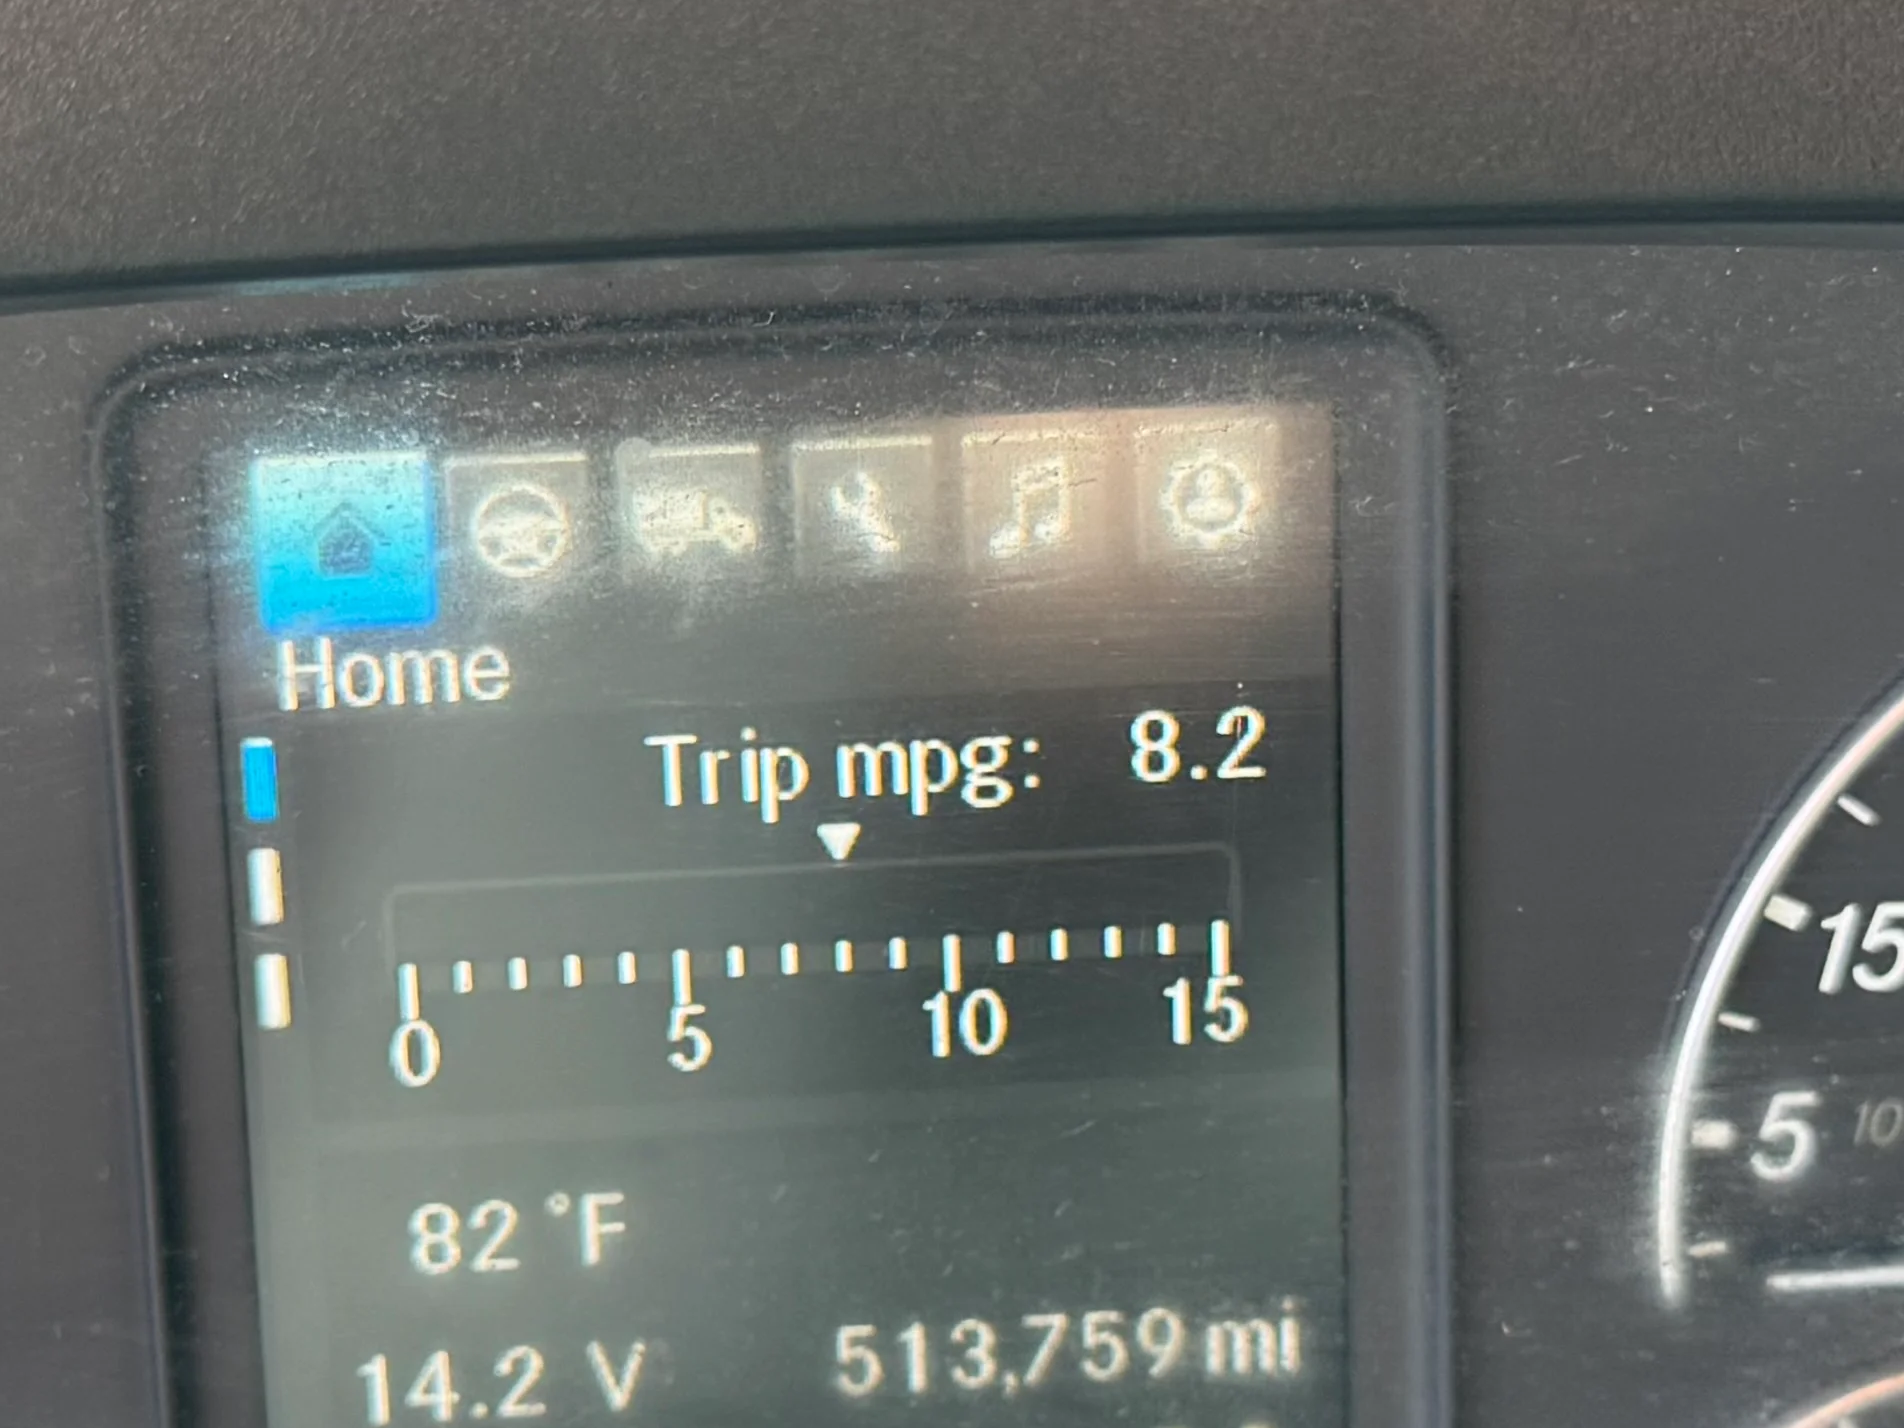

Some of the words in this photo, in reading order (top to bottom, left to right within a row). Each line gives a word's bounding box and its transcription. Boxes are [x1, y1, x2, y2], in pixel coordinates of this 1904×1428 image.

[276, 637, 512, 712] Home
[644, 725, 811, 823] Trip
[837, 733, 1042, 818] mpg:
[1129, 706, 1267, 786] 8.2
[390, 1018, 442, 1089] 0
[667, 1002, 712, 1074] 5
[922, 987, 1008, 1059] 10
[1163, 975, 1249, 1046] 15
[1750, 1089, 1822, 1182] 5
[408, 1197, 521, 1276] 82
[355, 1346, 548, 1428] 14.2
[588, 1338, 648, 1412] V
[833, 1306, 1183, 1399] 513,759
[1203, 1297, 1304, 1377] mi
